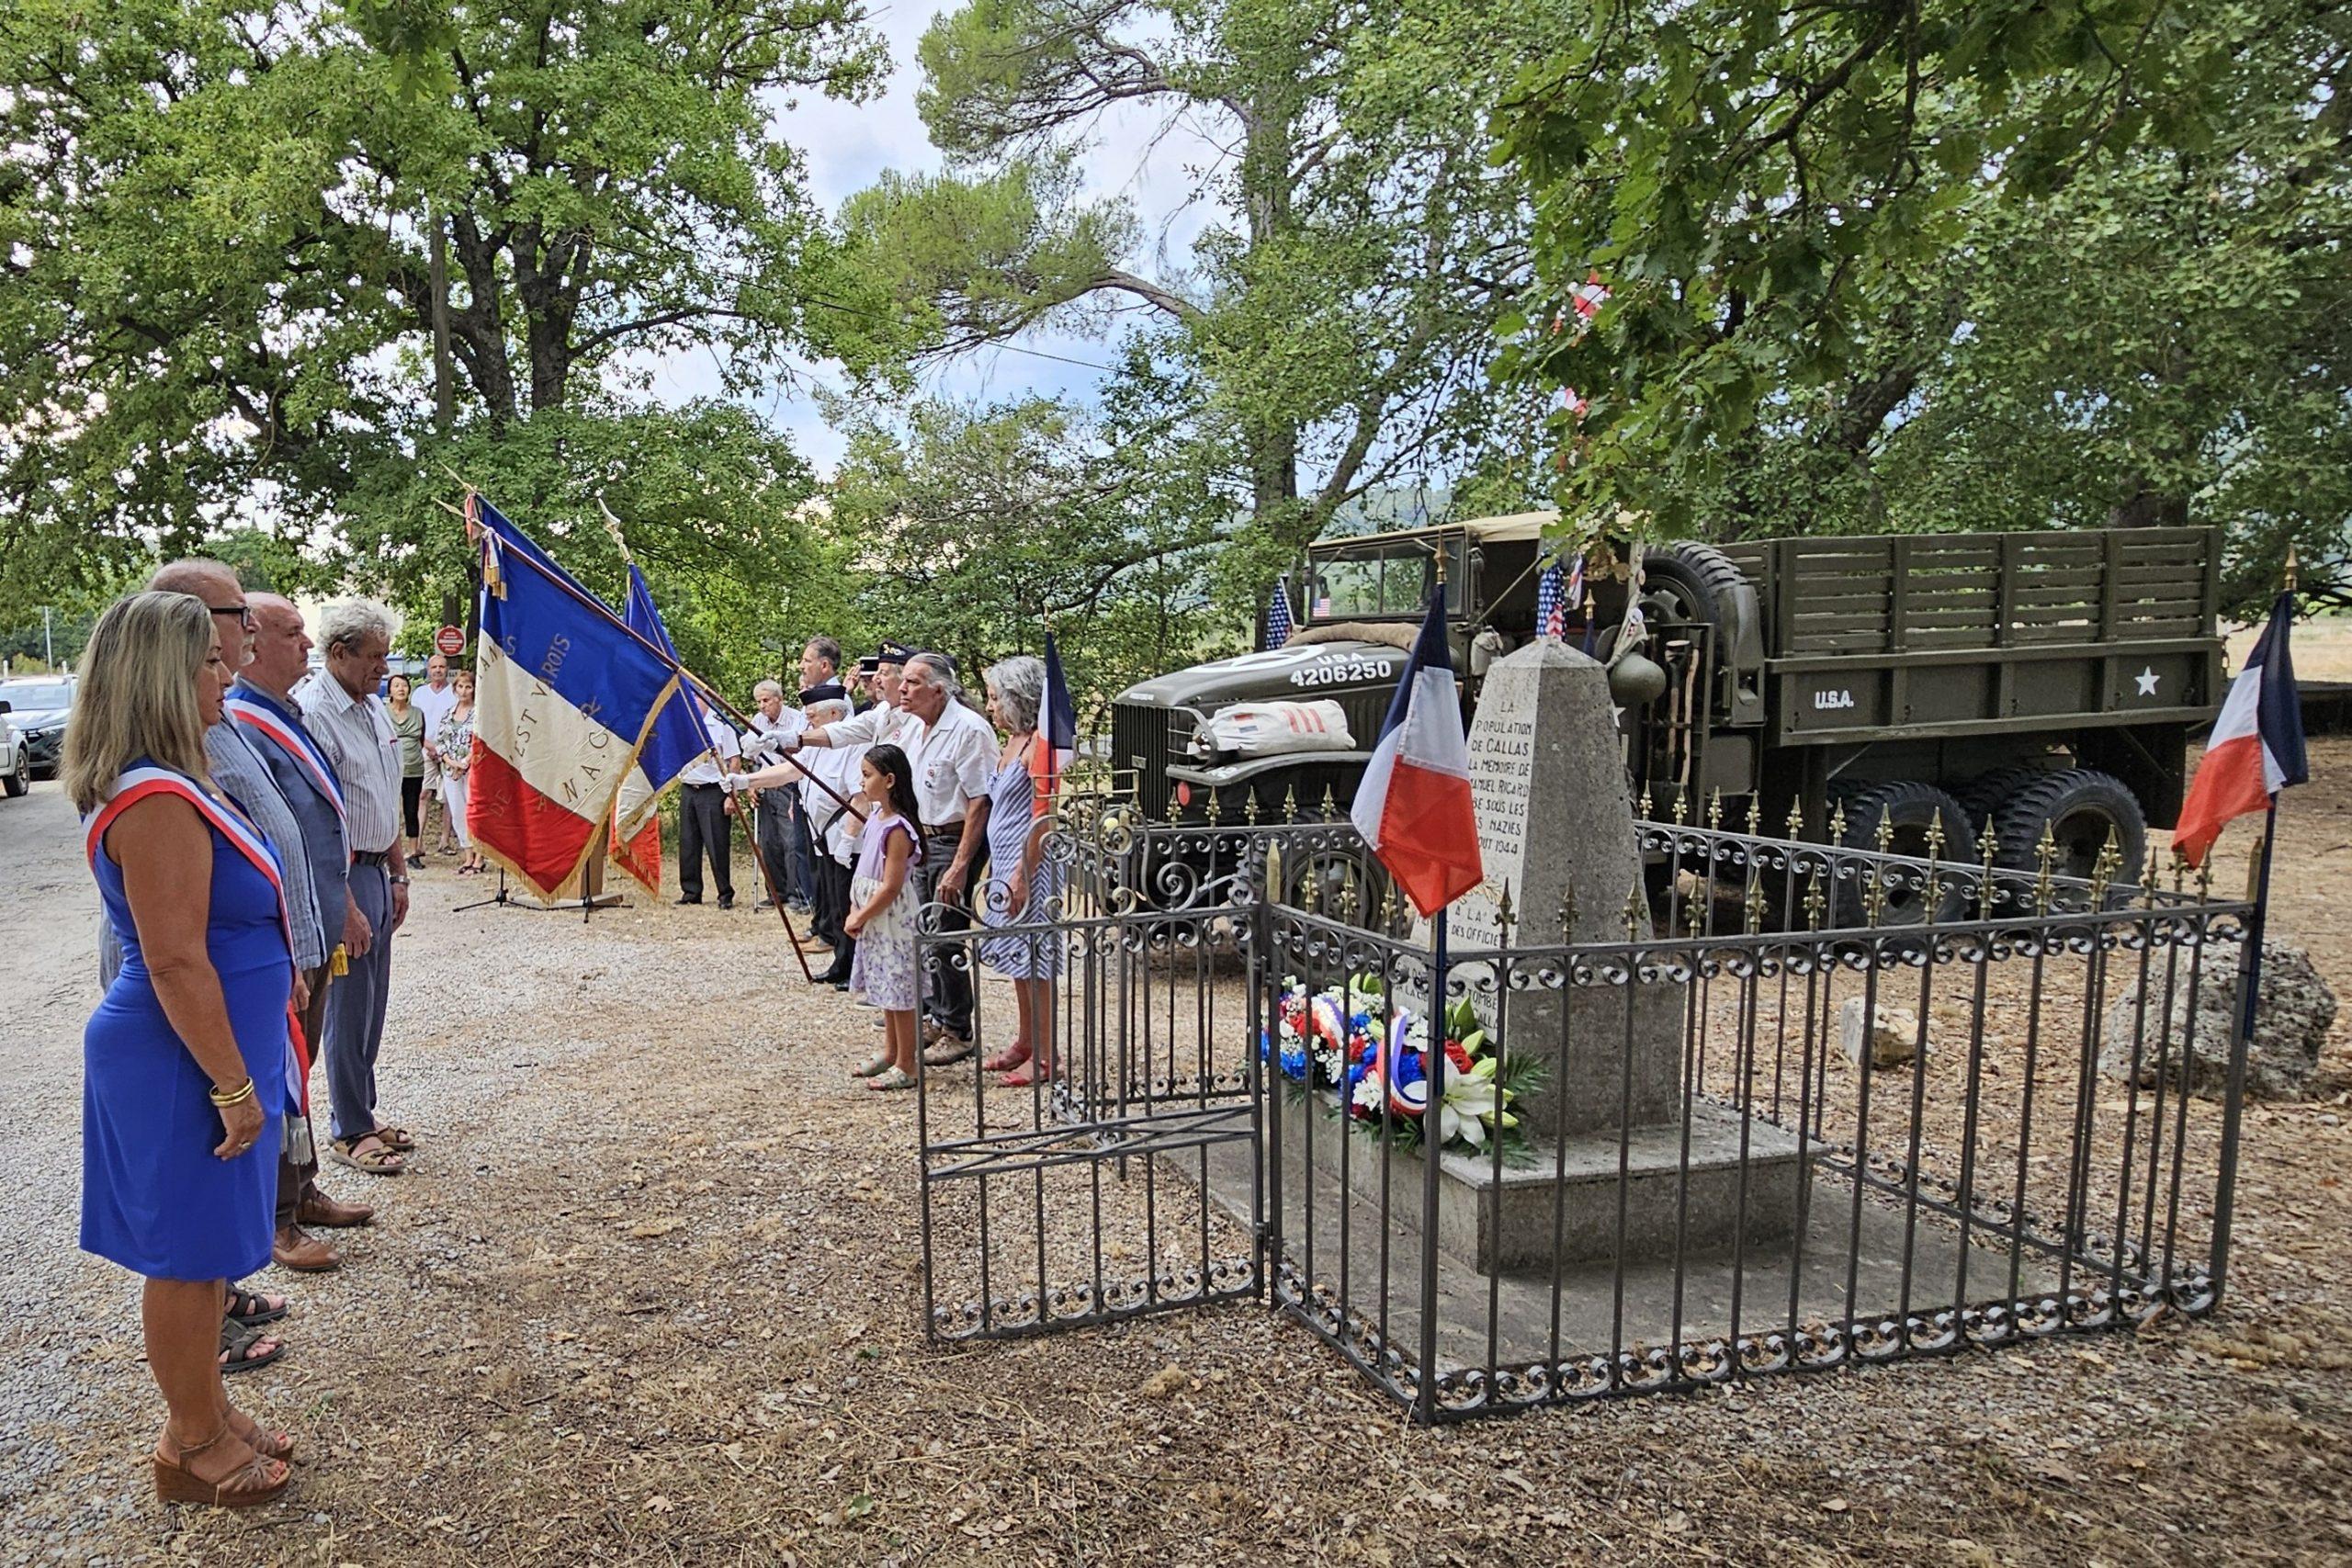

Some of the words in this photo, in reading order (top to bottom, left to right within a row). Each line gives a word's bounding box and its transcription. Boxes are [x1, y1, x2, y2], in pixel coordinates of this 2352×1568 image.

[1317, 652, 1364, 665] USA
[1290, 660, 1392, 687] 4206250
[1500, 701, 1514, 714] LA
[1815, 690, 1854, 709] U.S.A.
[1475, 719, 1532, 736] POPULATION
[1471, 739, 1483, 753] DE
[1487, 738, 1530, 757] CALLAS
[1480, 759, 1516, 775] MEMOIRE
[1518, 762, 1531, 777] DE
[1498, 779, 1530, 798] RICARD
[1486, 798, 1506, 814] SOUS
[1508, 801, 1525, 818] LES
[1489, 818, 1522, 837] NAZIES
[1495, 840, 1519, 855] 1944
[1452, 924, 1465, 938] DES
[1465, 926, 1498, 947] OFFICIE
